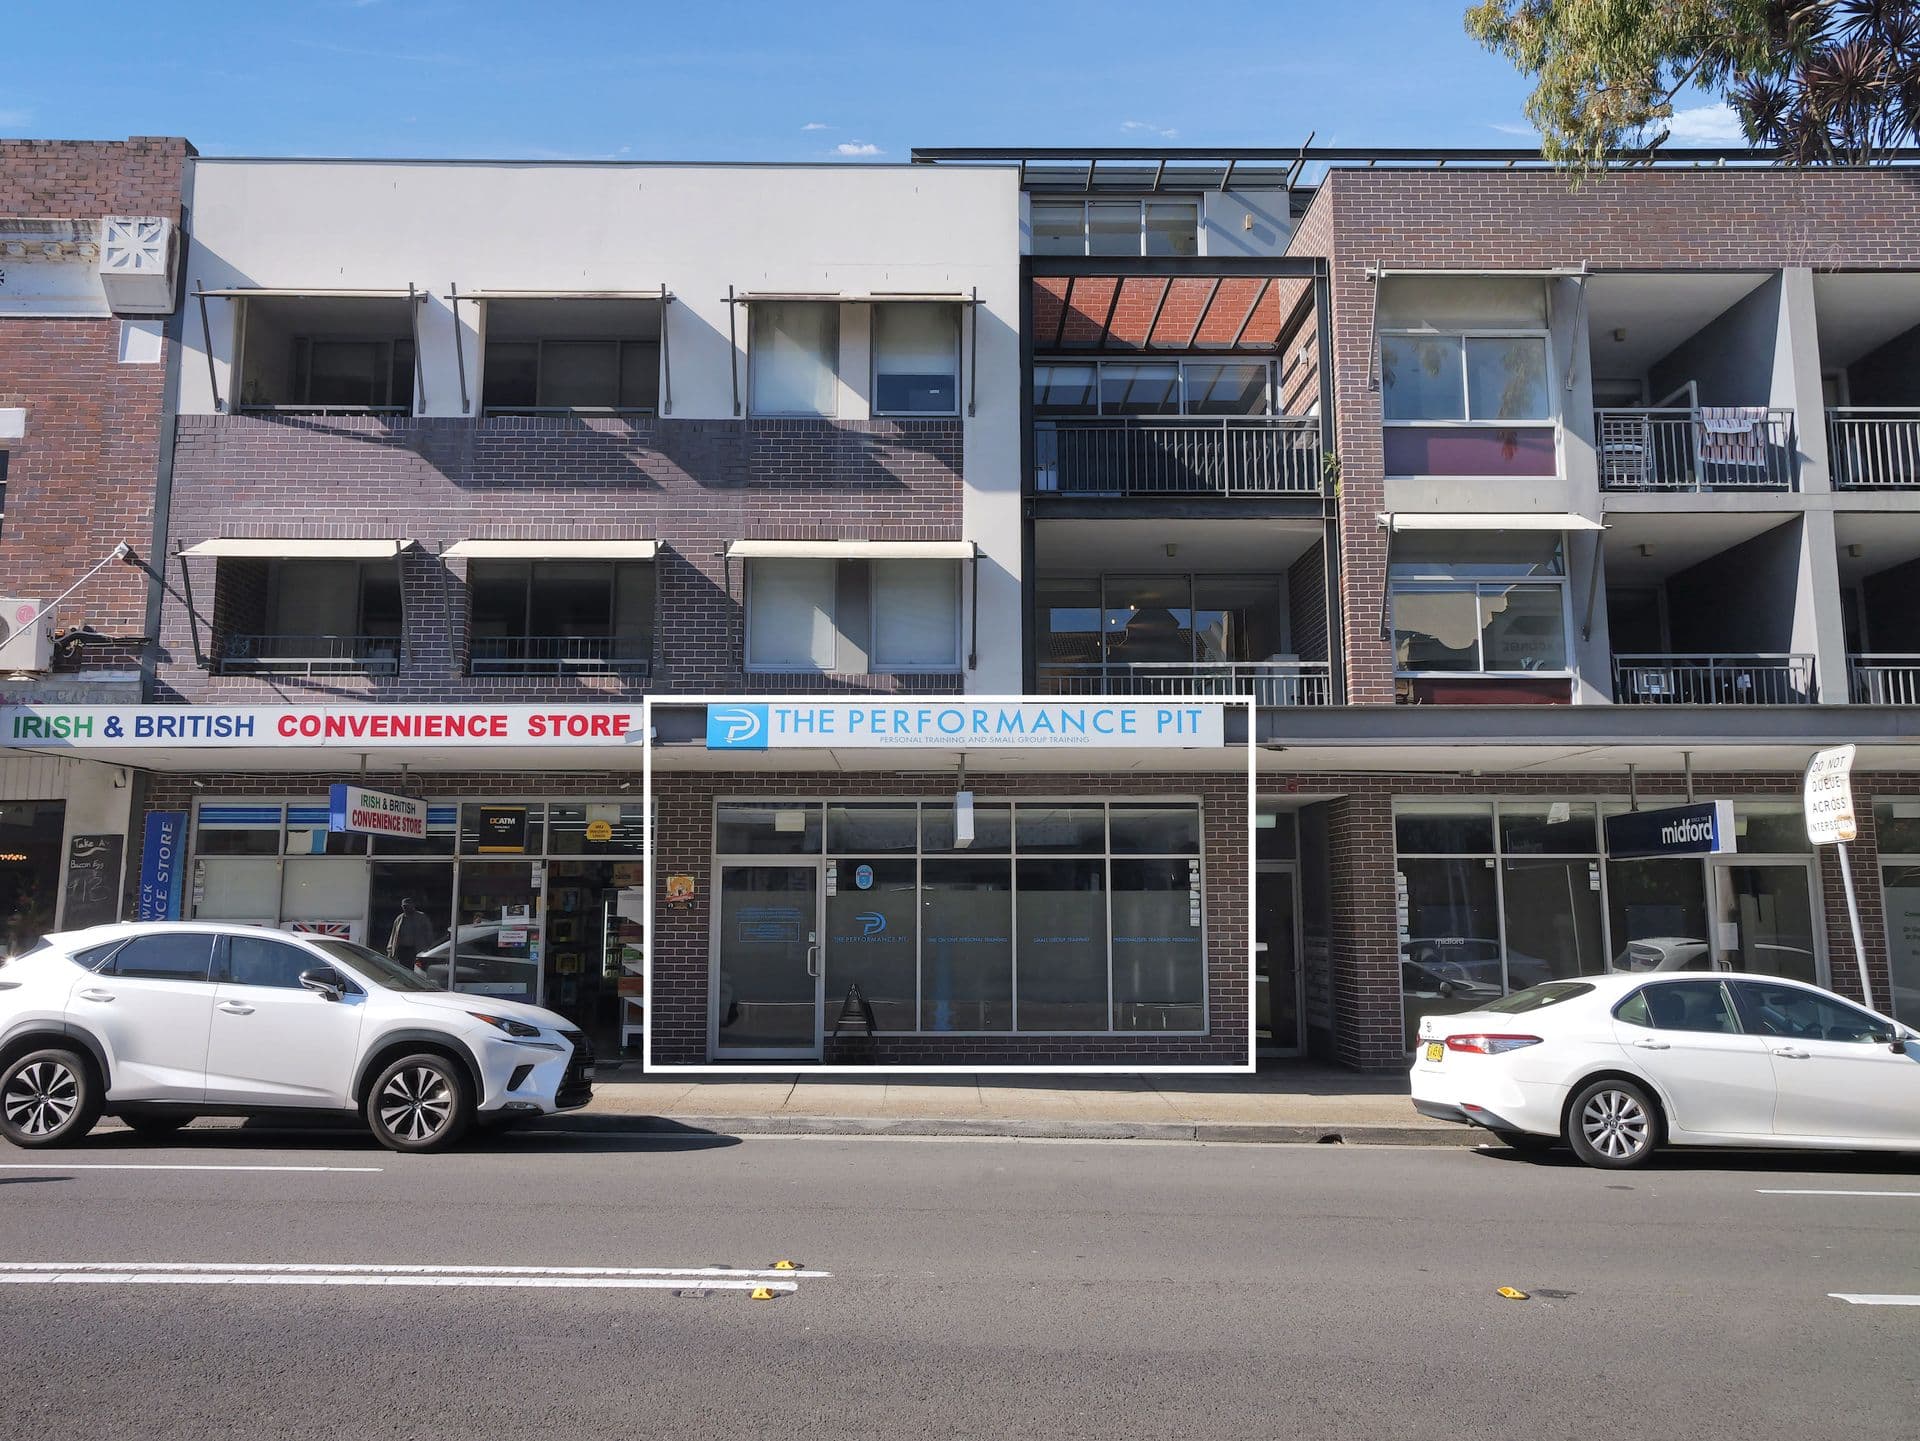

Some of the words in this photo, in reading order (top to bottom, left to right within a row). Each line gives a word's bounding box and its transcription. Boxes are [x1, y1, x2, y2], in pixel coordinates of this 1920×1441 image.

[13, 715, 93, 738] IRISH
[103, 715, 124, 738] &
[134, 715, 255, 738] BRITISH
[277, 714, 508, 738] CONVENIENCE
[527, 714, 631, 737] STORE
[775, 709, 835, 733] THE
[849, 708, 1137, 734] PERFORMANCE
[1157, 709, 1202, 734] PIT
[880, 736, 923, 744] PERSONAL
[925, 736, 966, 744] TRAINING
[967, 736, 988, 744] AND
[989, 736, 1016, 744] SMALL
[1017, 736, 1048, 744] GROUP
[1049, 736, 1090, 744] TRAINING
[1812, 761, 1824, 773] DO
[1827, 756, 1846, 770] NOT
[1811, 775, 1841, 793] QUEUE
[360, 794, 381, 809] IRISH
[382, 797, 388, 810] &
[389, 800, 416, 815] BRITISH
[1812, 796, 1847, 814] ACROSS
[352, 809, 401, 832] CONVENIENCE
[401, 816, 422, 834] STORE
[1661, 815, 1713, 844] midford
[73, 837, 94, 849] Take
[157, 821, 173, 883] STORE
